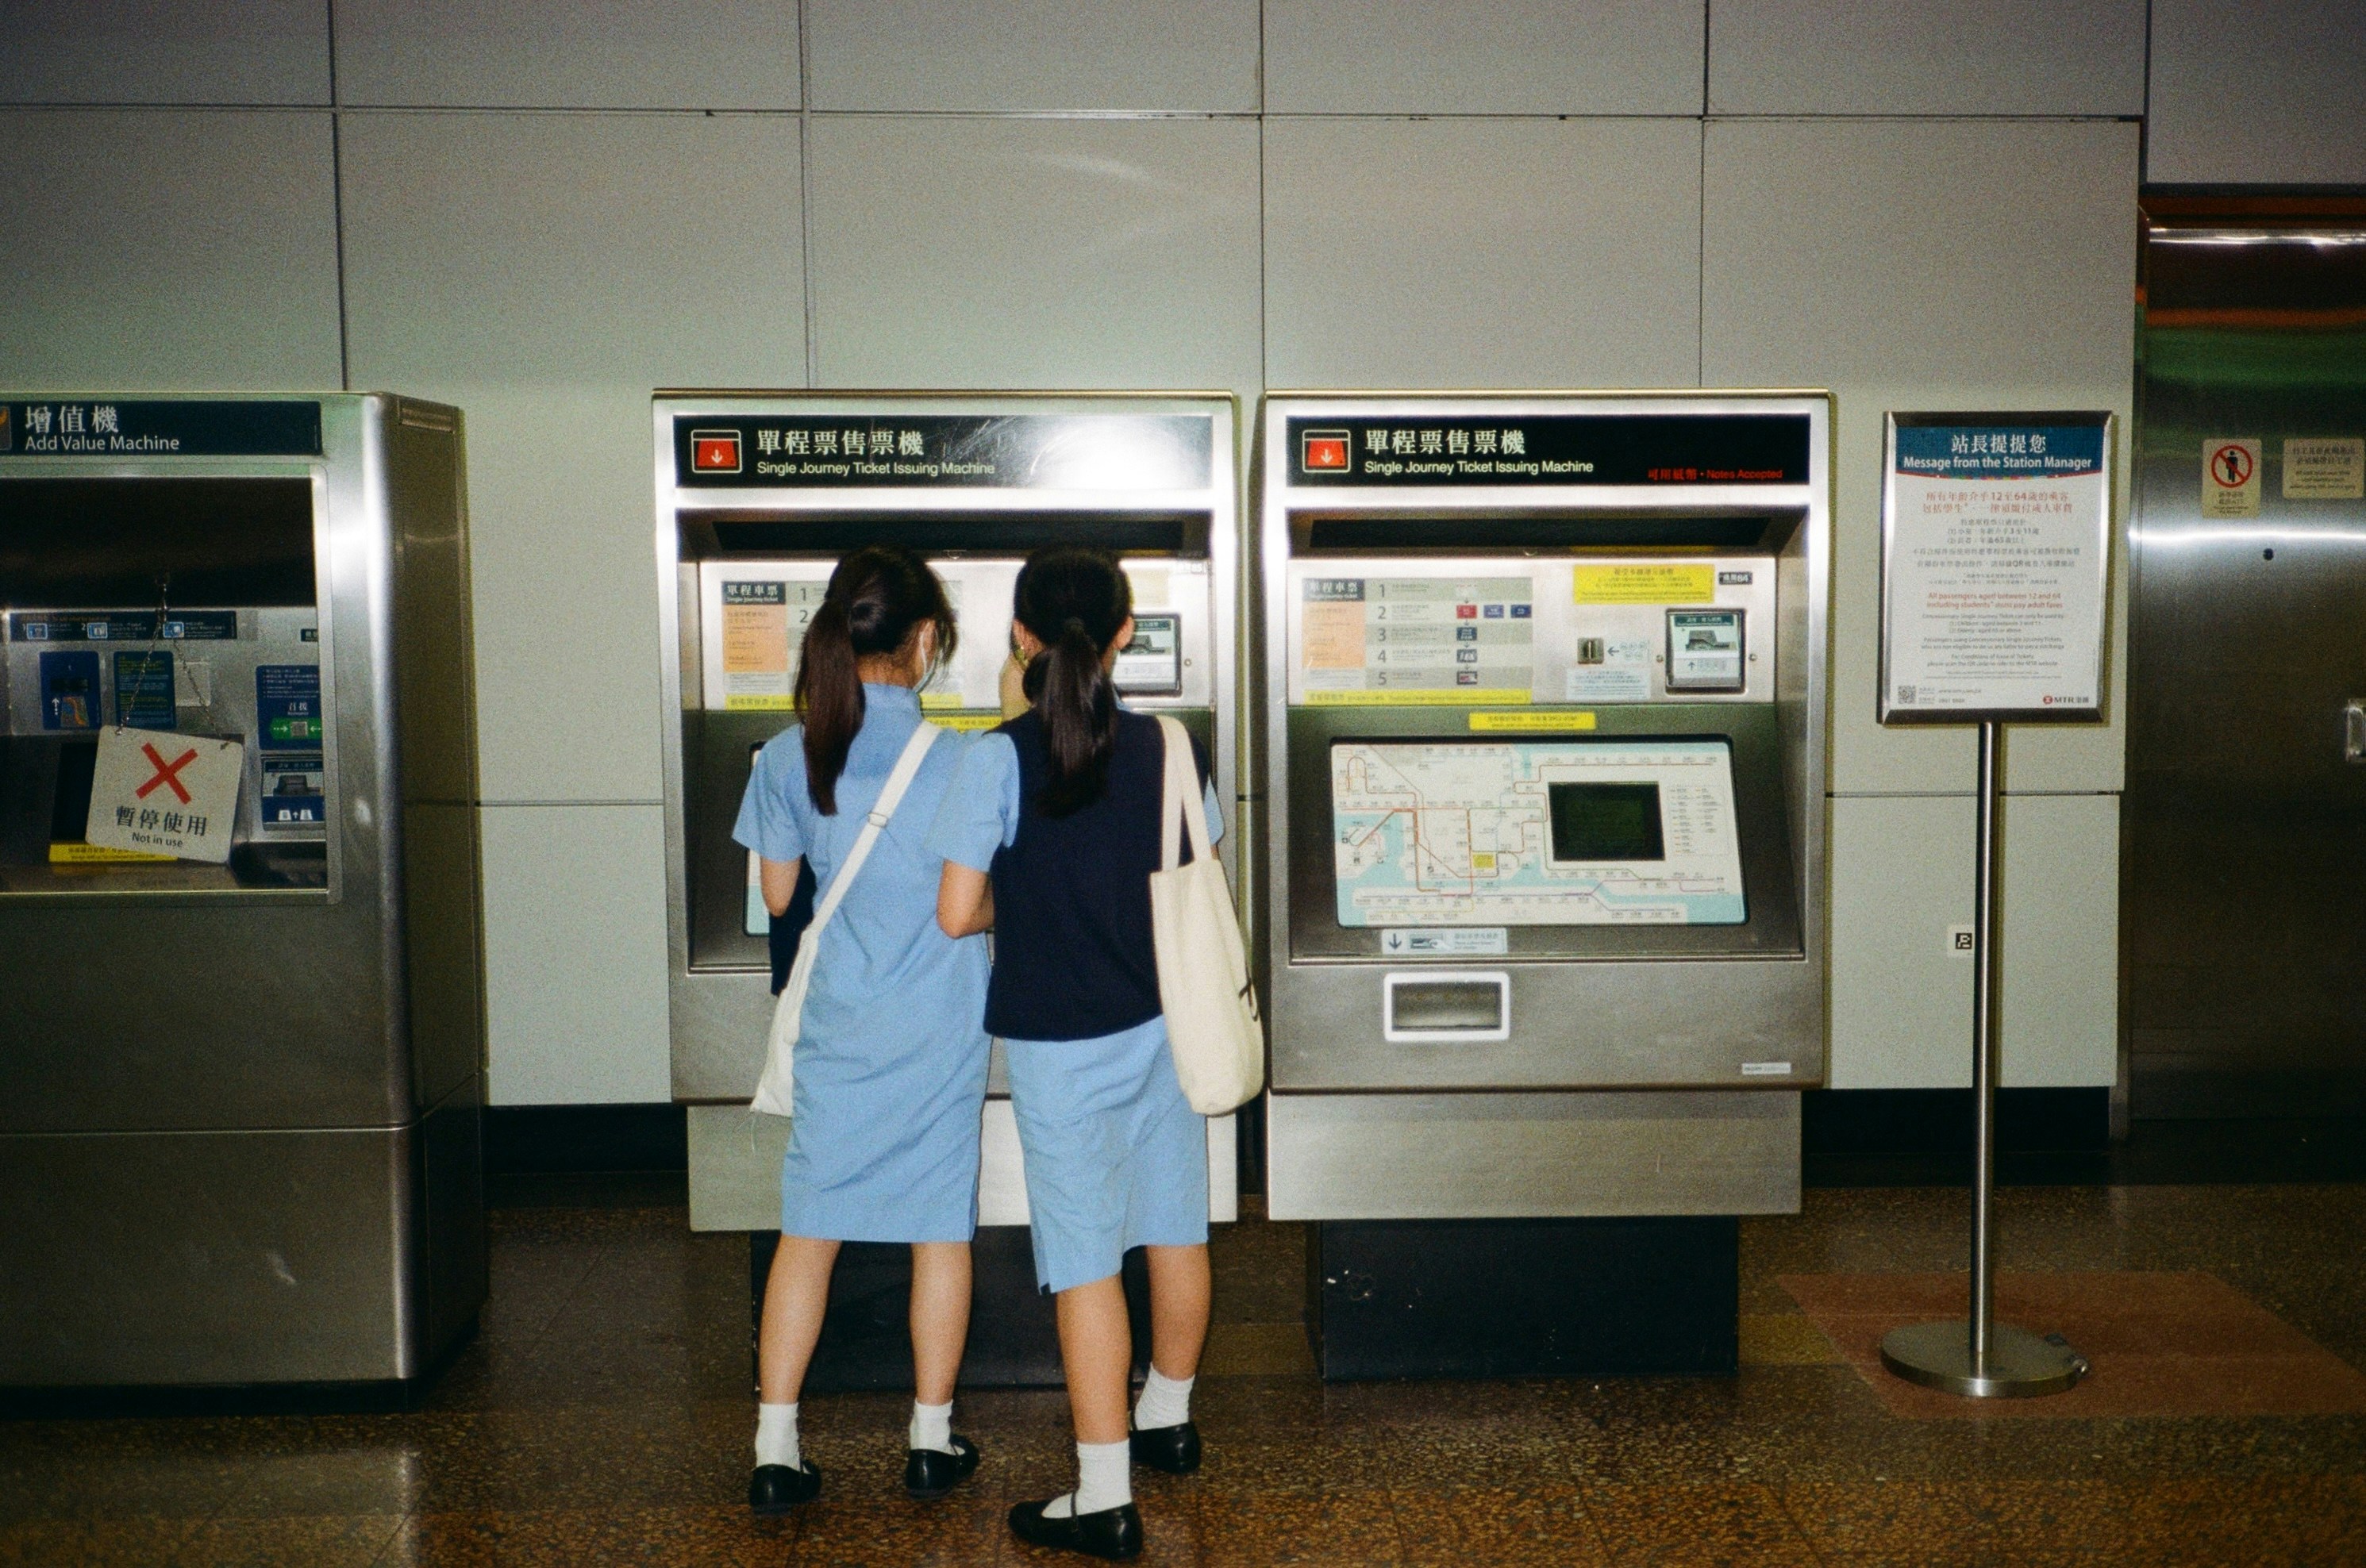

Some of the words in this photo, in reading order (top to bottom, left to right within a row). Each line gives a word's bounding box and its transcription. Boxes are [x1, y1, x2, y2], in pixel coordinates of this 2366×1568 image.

[25, 405, 119, 433] 增值機
[25, 436, 58, 451] Add
[61, 436, 106, 451] Value
[110, 436, 179, 451] Machine
[756, 429, 924, 455] 單程票售票機
[1364, 429, 1525, 455] 單程票售票機
[1951, 434, 2046, 454] 站長提提您
[757, 461, 797, 476] Single
[800, 462, 850, 476] Journey
[853, 462, 891, 474] Ticket
[894, 462, 938, 477] Issuing
[942, 462, 995, 474] Machine
[1364, 461, 1402, 475] Single
[1406, 461, 1454, 475] Journey
[1457, 461, 1492, 472] Ticket
[1496, 461, 1538, 475] Issuing
[1542, 461, 1594, 472] Machine
[1903, 457, 1951, 471] Message
[1953, 456, 1979, 467] from
[1982, 456, 2000, 467] the
[2003, 456, 2042, 467] Station
[2045, 457, 2092, 471] Manager
[1706, 469, 1735, 479] Notes
[1737, 469, 1783, 480] Accepted
[800, 588, 806, 601] 1
[1379, 584, 1385, 598] 1
[799, 609, 808, 623] 2
[1377, 605, 1387, 620] 2
[1378, 628, 1387, 642] 3
[1377, 649, 1387, 663] 4
[1378, 671, 1387, 686] 5
[116, 805, 207, 836] 暫停使用
[132, 832, 150, 844] Not
[153, 833, 163, 845] in
[166, 838, 183, 847] use
